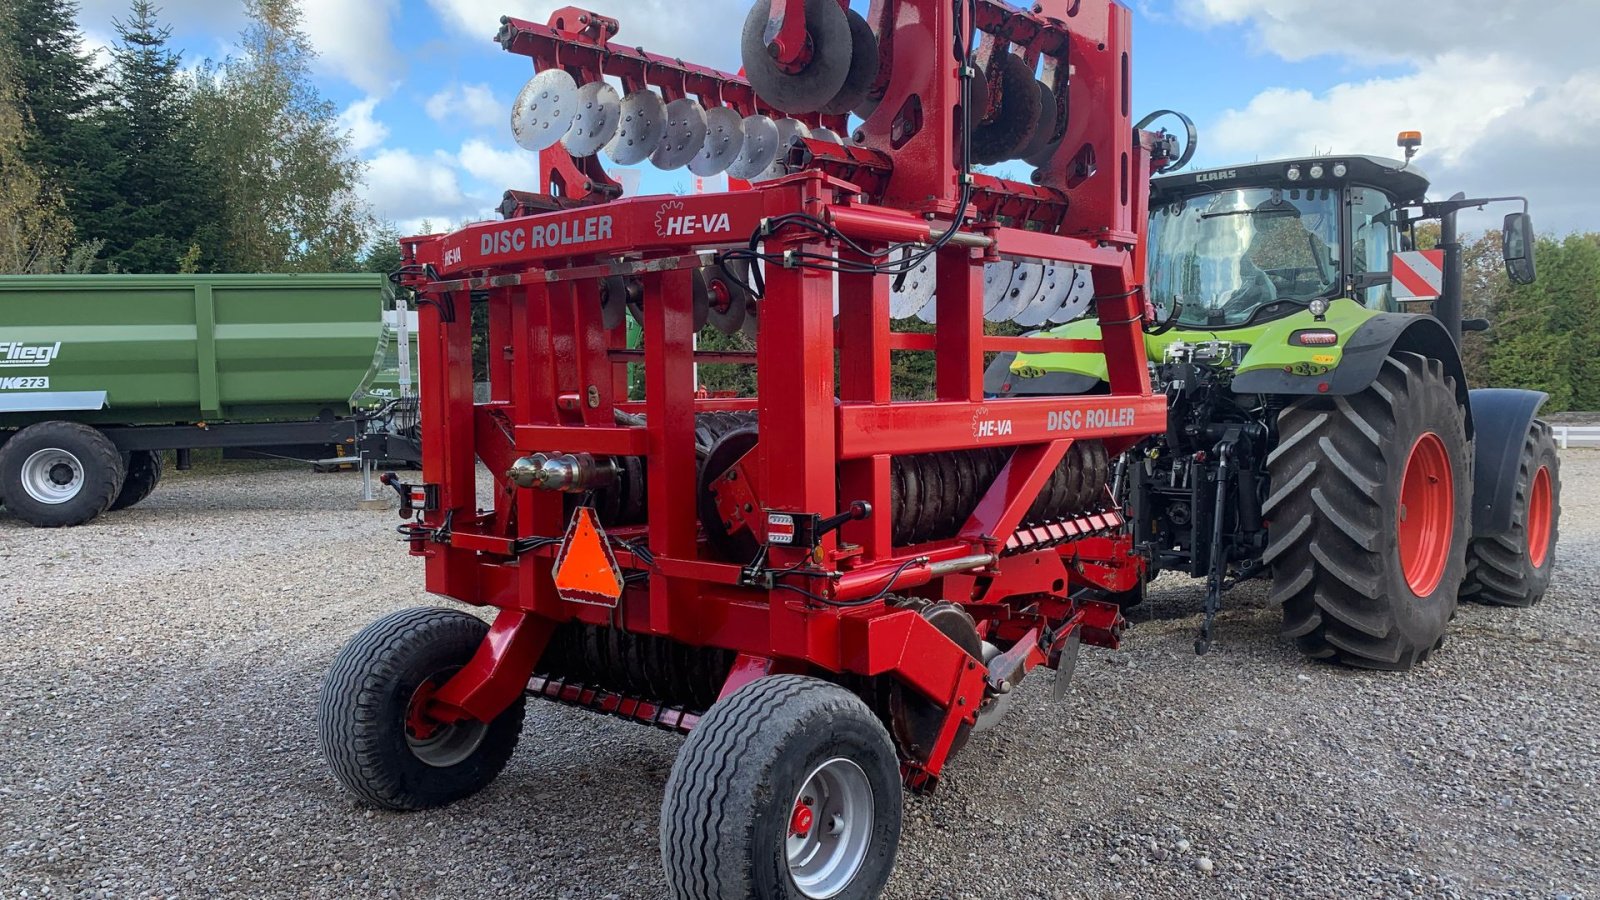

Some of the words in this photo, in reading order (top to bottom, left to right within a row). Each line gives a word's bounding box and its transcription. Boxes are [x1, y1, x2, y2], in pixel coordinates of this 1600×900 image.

[1195, 170, 1237, 183] CLAAS
[666, 213, 731, 236] HE-VA
[480, 228, 526, 256] DISC
[531, 215, 613, 249] ROLLER
[444, 247, 462, 267] HE-VA
[0, 341, 62, 364] Fliegl
[20, 378, 46, 388] 273
[978, 420, 1013, 437] HE-VA
[1047, 410, 1082, 431] DISC
[1085, 408, 1135, 429] ROLLER
